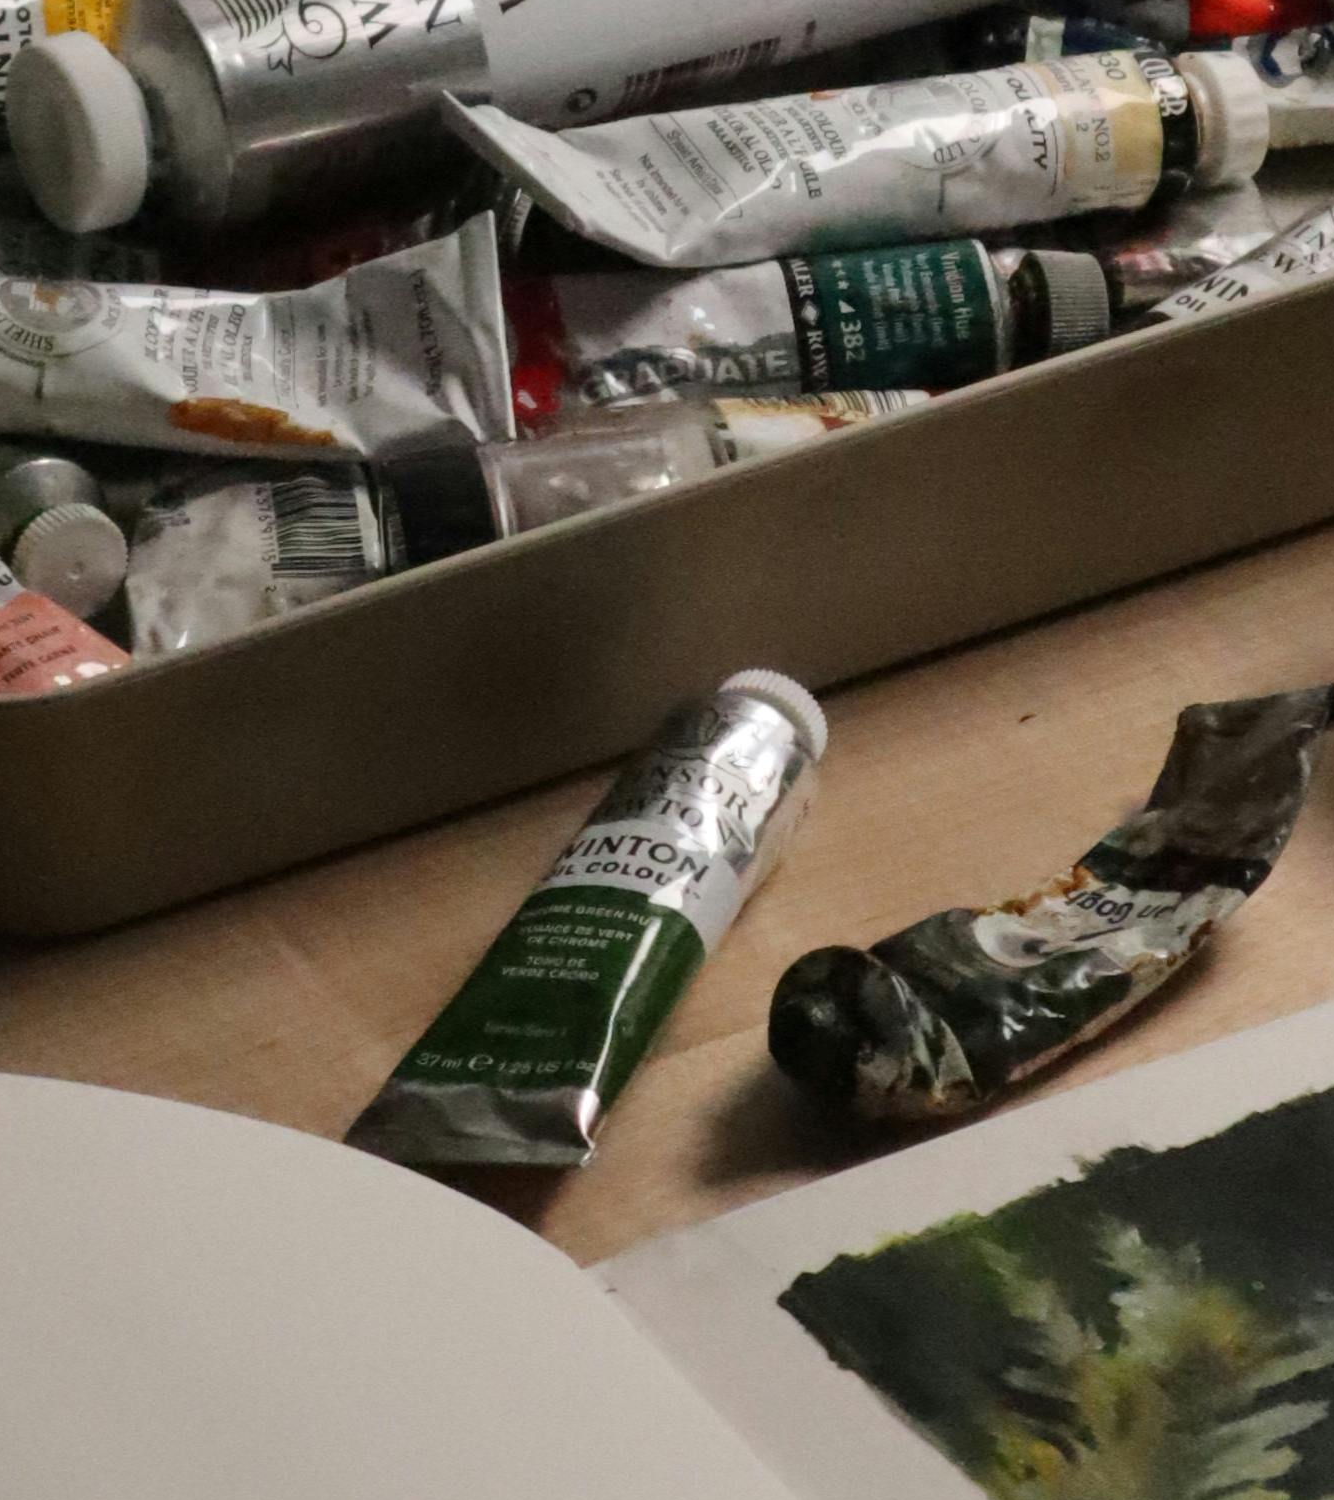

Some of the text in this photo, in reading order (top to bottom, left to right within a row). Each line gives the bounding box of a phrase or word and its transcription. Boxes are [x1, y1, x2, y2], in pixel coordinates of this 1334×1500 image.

[1090, 115, 1111, 164] NO.2
[932, 141, 967, 167] LTD
[938, 250, 972, 341] Viridian Hue
[839, 320, 867, 363] 382
[584, 860, 679, 888] COLOU
[575, 904, 624, 919] GREEN
[548, 935, 610, 949] CHROME
[574, 924, 594, 936] DE
[597, 927, 635, 943] VERT
[566, 957, 587, 968] DE
[548, 967, 601, 981] CROMO
